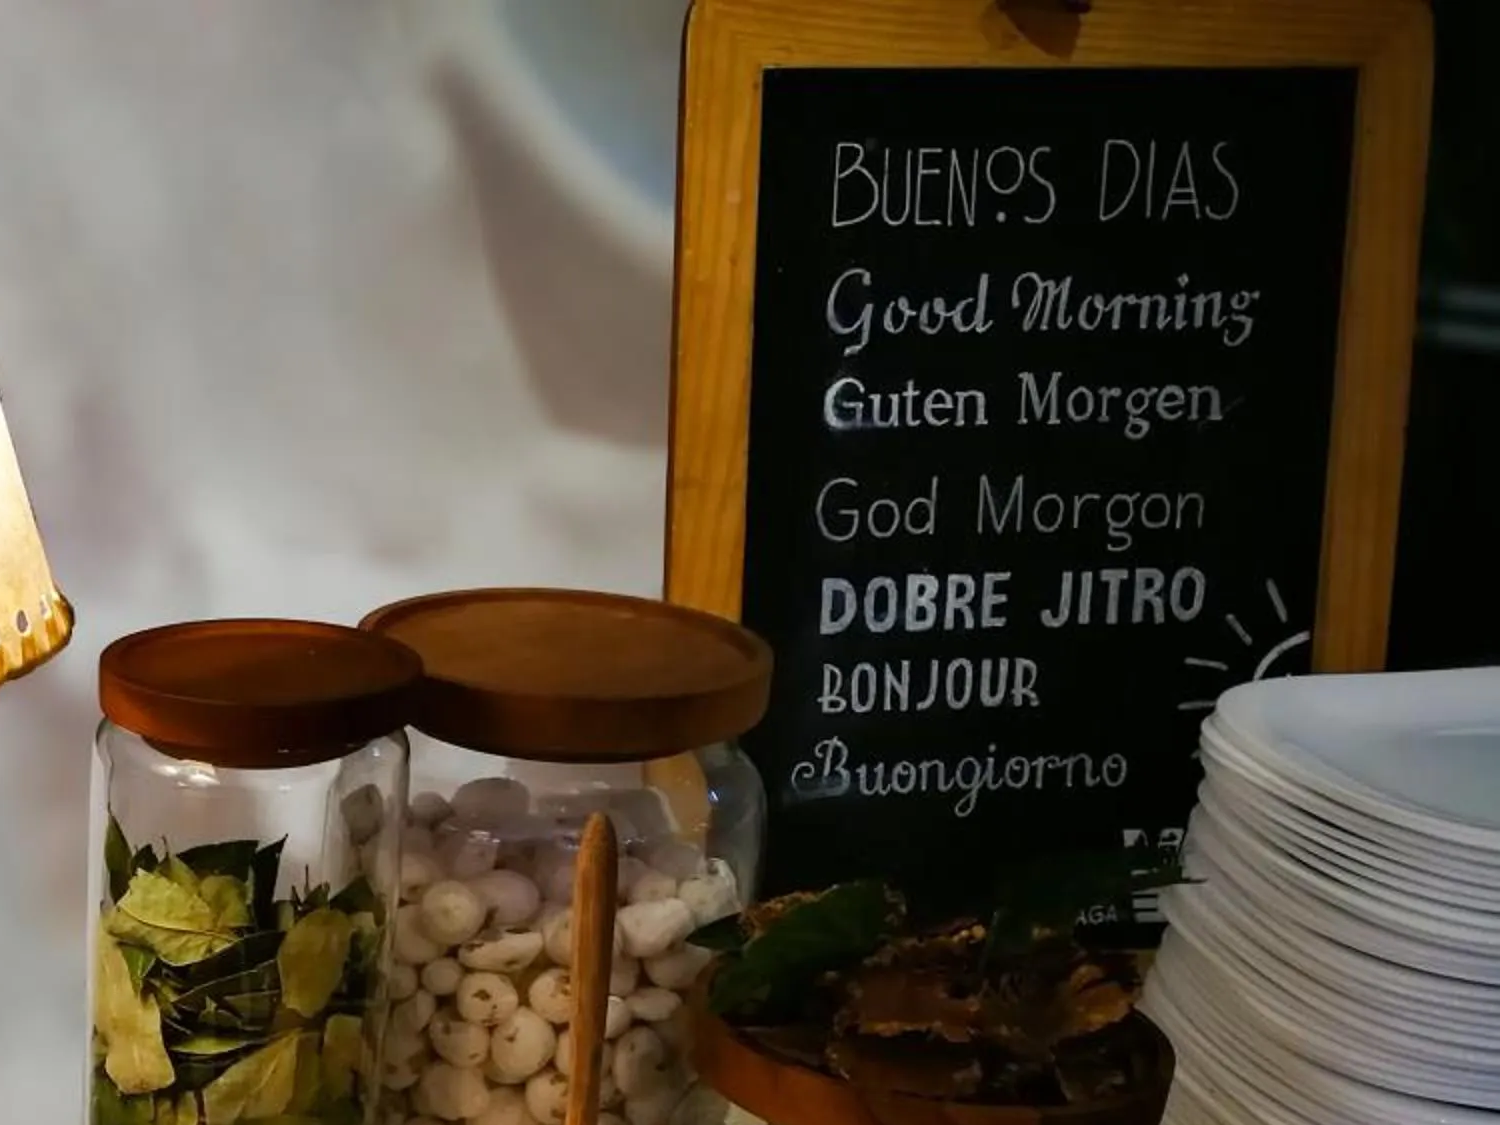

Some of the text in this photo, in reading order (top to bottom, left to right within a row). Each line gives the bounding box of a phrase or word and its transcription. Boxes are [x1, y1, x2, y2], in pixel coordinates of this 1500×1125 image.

[832, 139, 1239, 227] BUENOS DIAS
[826, 267, 1260, 357] Good Morning
[823, 371, 1224, 440] Guten Morgen
[816, 474, 1205, 552] God Morgon
[819, 566, 1206, 634] DOBRE JITRO
[817, 658, 1041, 713] BONJOUR
[791, 736, 1127, 817] Buongiorno
